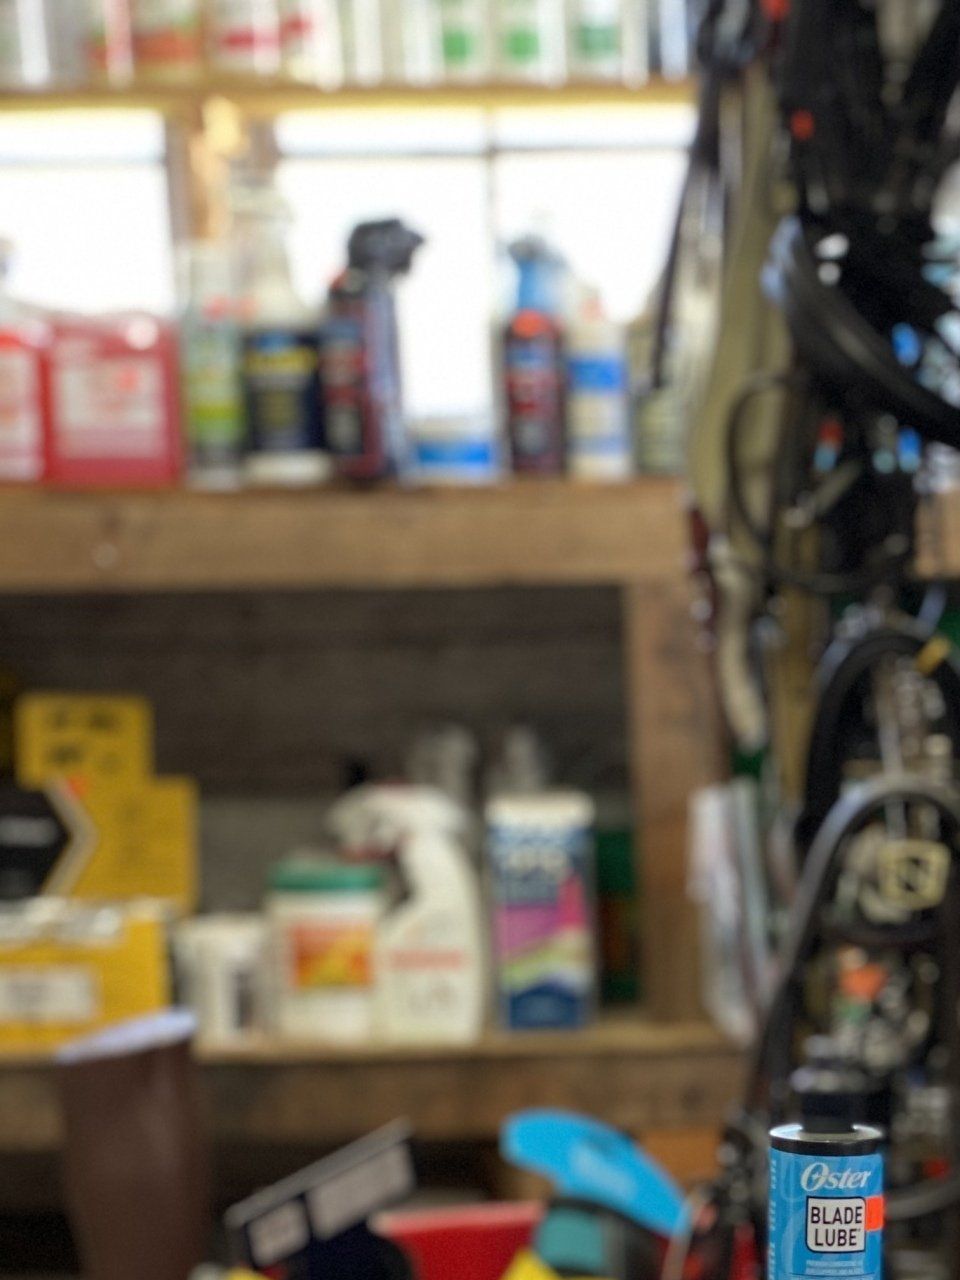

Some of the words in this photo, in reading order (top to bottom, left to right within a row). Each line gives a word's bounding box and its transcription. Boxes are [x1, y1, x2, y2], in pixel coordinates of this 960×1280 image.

[801, 1161, 872, 1192] Oster
[810, 1205, 863, 1226] BLADE
[813, 1228, 860, 1248] LUBE
